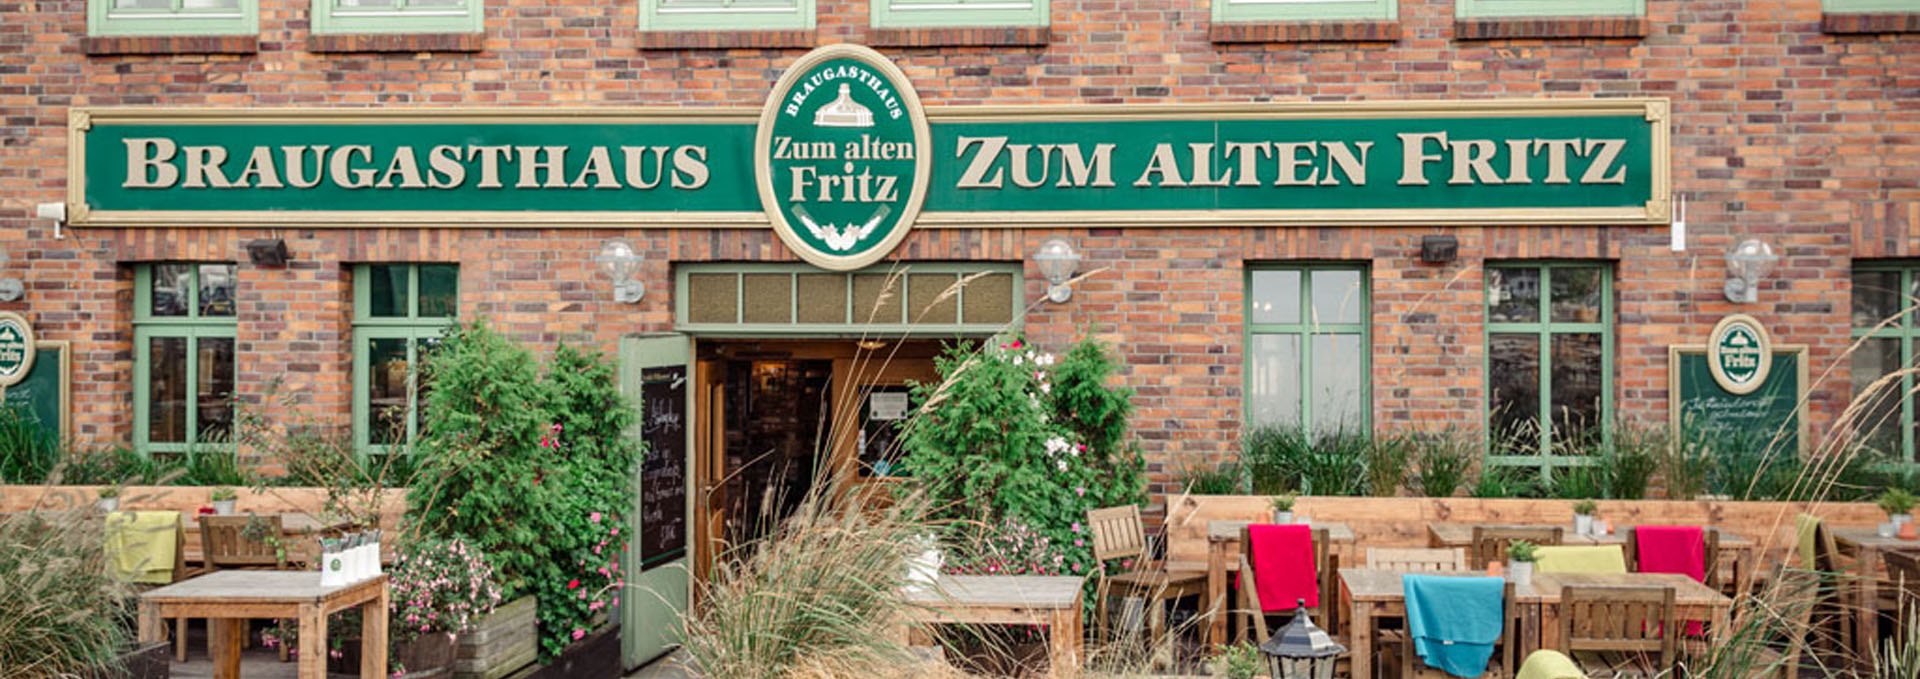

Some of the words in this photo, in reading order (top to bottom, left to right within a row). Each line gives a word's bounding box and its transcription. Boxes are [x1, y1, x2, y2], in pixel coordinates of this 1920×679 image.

[785, 65, 903, 120] BRAUGASTHAUS
[122, 137, 710, 189] BRAUGASTHAUS
[773, 135, 836, 160] Zum
[844, 133, 914, 160] alten
[956, 135, 1116, 189] ZUM
[1133, 140, 1375, 188] ALTEN
[1397, 131, 1627, 186] FRITZ
[788, 161, 899, 203] Fritz
